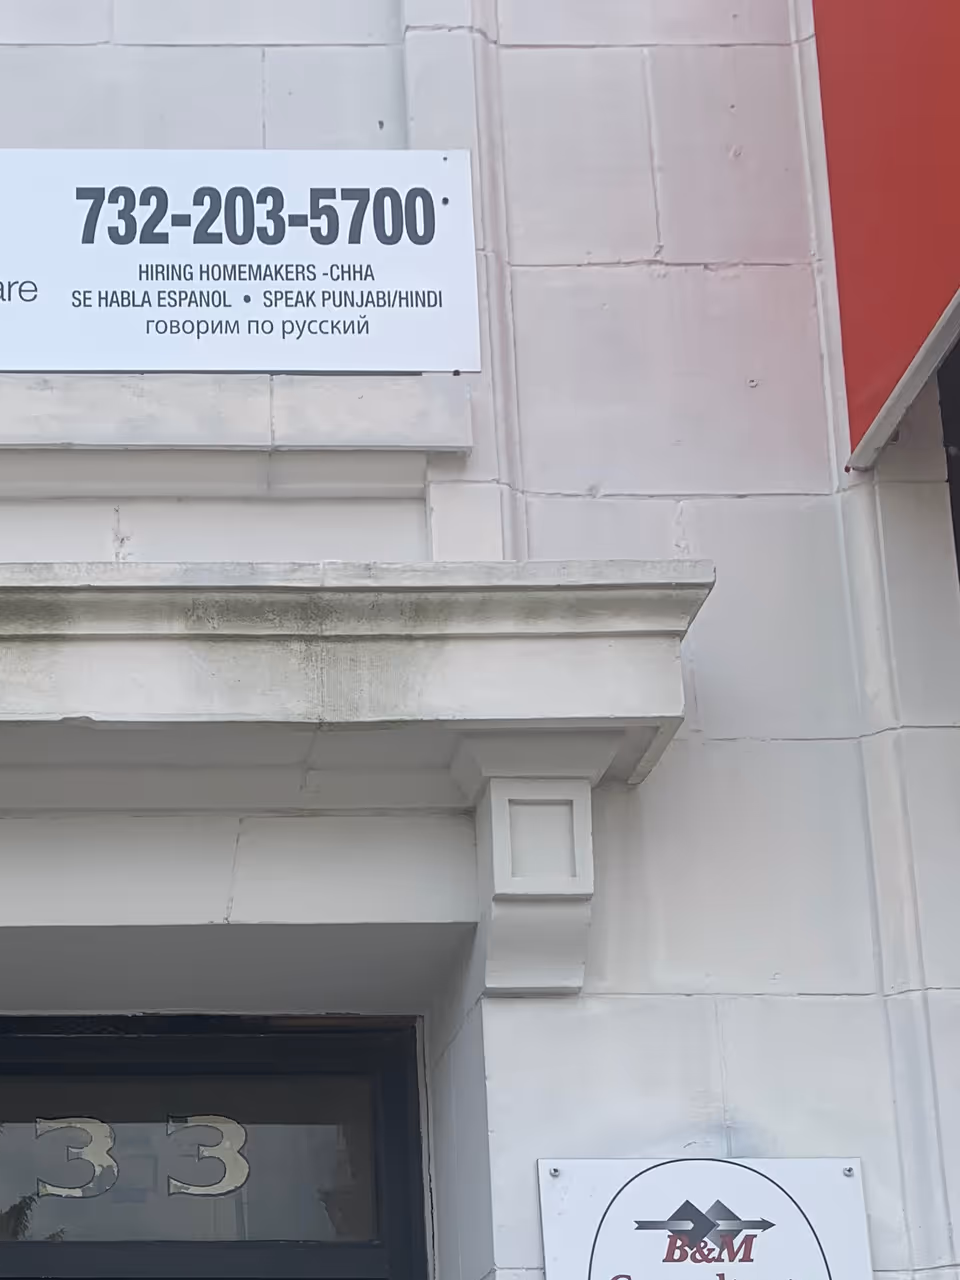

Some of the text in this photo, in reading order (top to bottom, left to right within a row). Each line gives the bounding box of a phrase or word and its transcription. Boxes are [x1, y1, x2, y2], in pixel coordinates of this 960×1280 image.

[76, 186, 435, 245] 732-203-5700
[139, 264, 374, 281] HIRING HOMEMAKERS -CHHA
[72, 290, 442, 307] SE HABLA ESPANOL SPEAK PUNJABI/HINDI
[147, 315, 368, 339] говорим по русский
[662, 1234, 757, 1264] B&M
